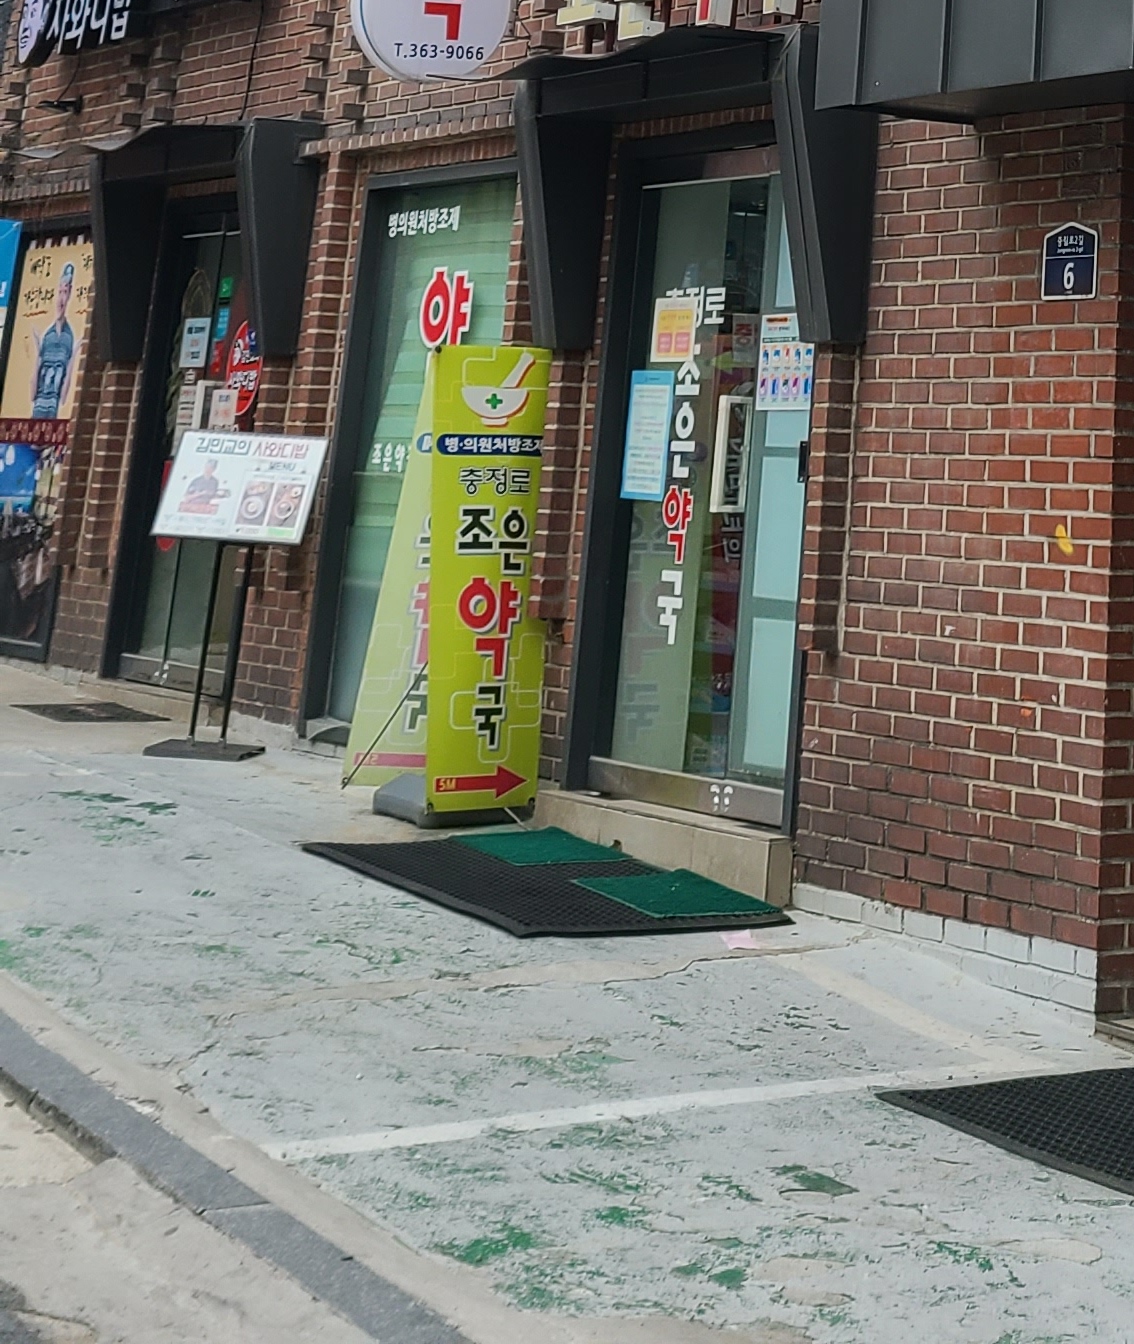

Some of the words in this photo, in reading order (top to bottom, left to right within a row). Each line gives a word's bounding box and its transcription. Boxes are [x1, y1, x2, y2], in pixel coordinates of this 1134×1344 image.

[394, 42, 485, 61] T.363-9066
[388, 204, 461, 238] 병의원처방조제
[1063, 262, 1075, 290] 6
[196, 437, 252, 456] 김민교의
[252, 441, 309, 460] 사와디밥
[371, 442, 411, 473] 조은약
[459, 467, 531, 497] 충정로
